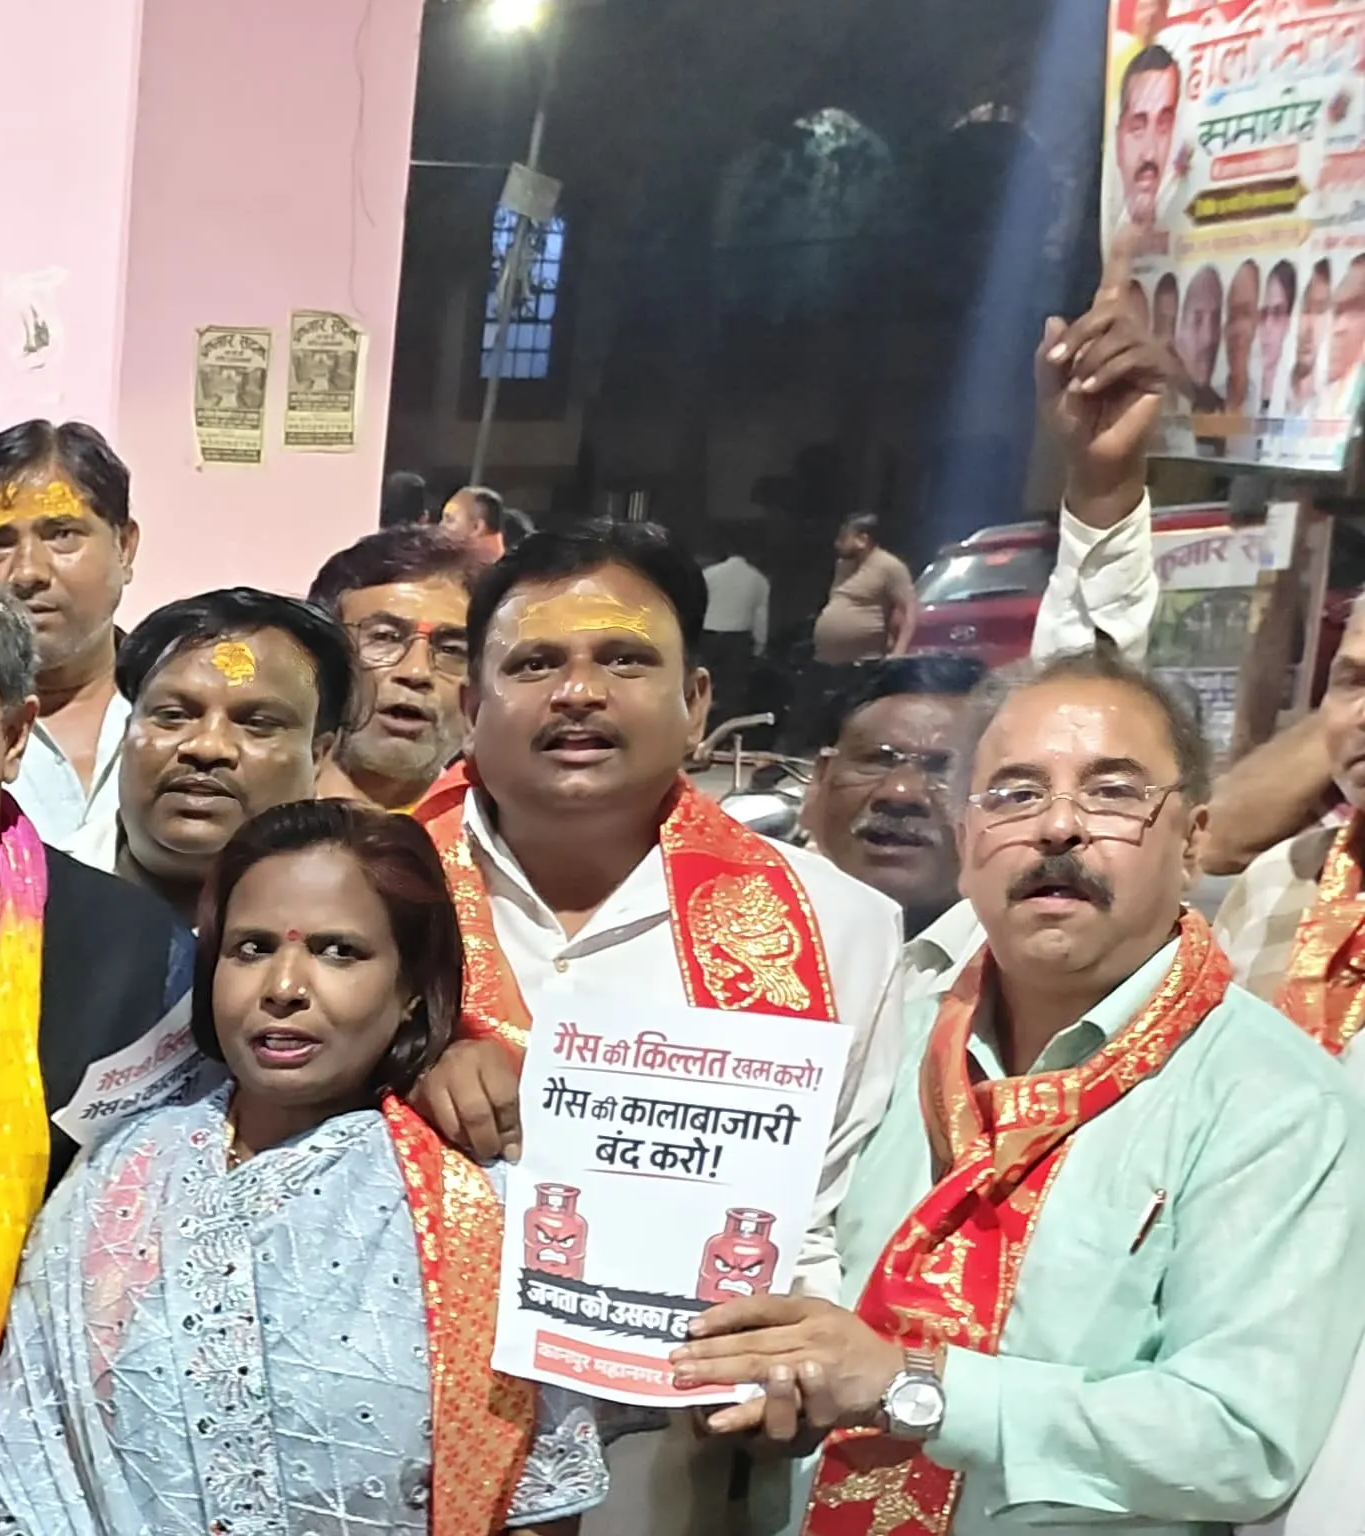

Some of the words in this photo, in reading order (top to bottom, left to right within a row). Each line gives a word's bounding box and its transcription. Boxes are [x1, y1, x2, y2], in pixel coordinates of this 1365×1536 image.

[554, 1022, 602, 1064] गैस
[603, 1040, 632, 1067] की
[633, 1031, 731, 1079] किल्लत
[773, 1058, 823, 1092] करो!
[542, 1076, 592, 1119] गैस
[591, 1096, 619, 1122] की
[620, 1096, 801, 1146] कालाबाजारी
[596, 1130, 645, 1170] बंद
[650, 1137, 723, 1178] करो!
[527, 1280, 578, 1314] जनता
[580, 1290, 612, 1322] को
[610, 1301, 669, 1332] उसका
[671, 1309, 701, 1340] ह
